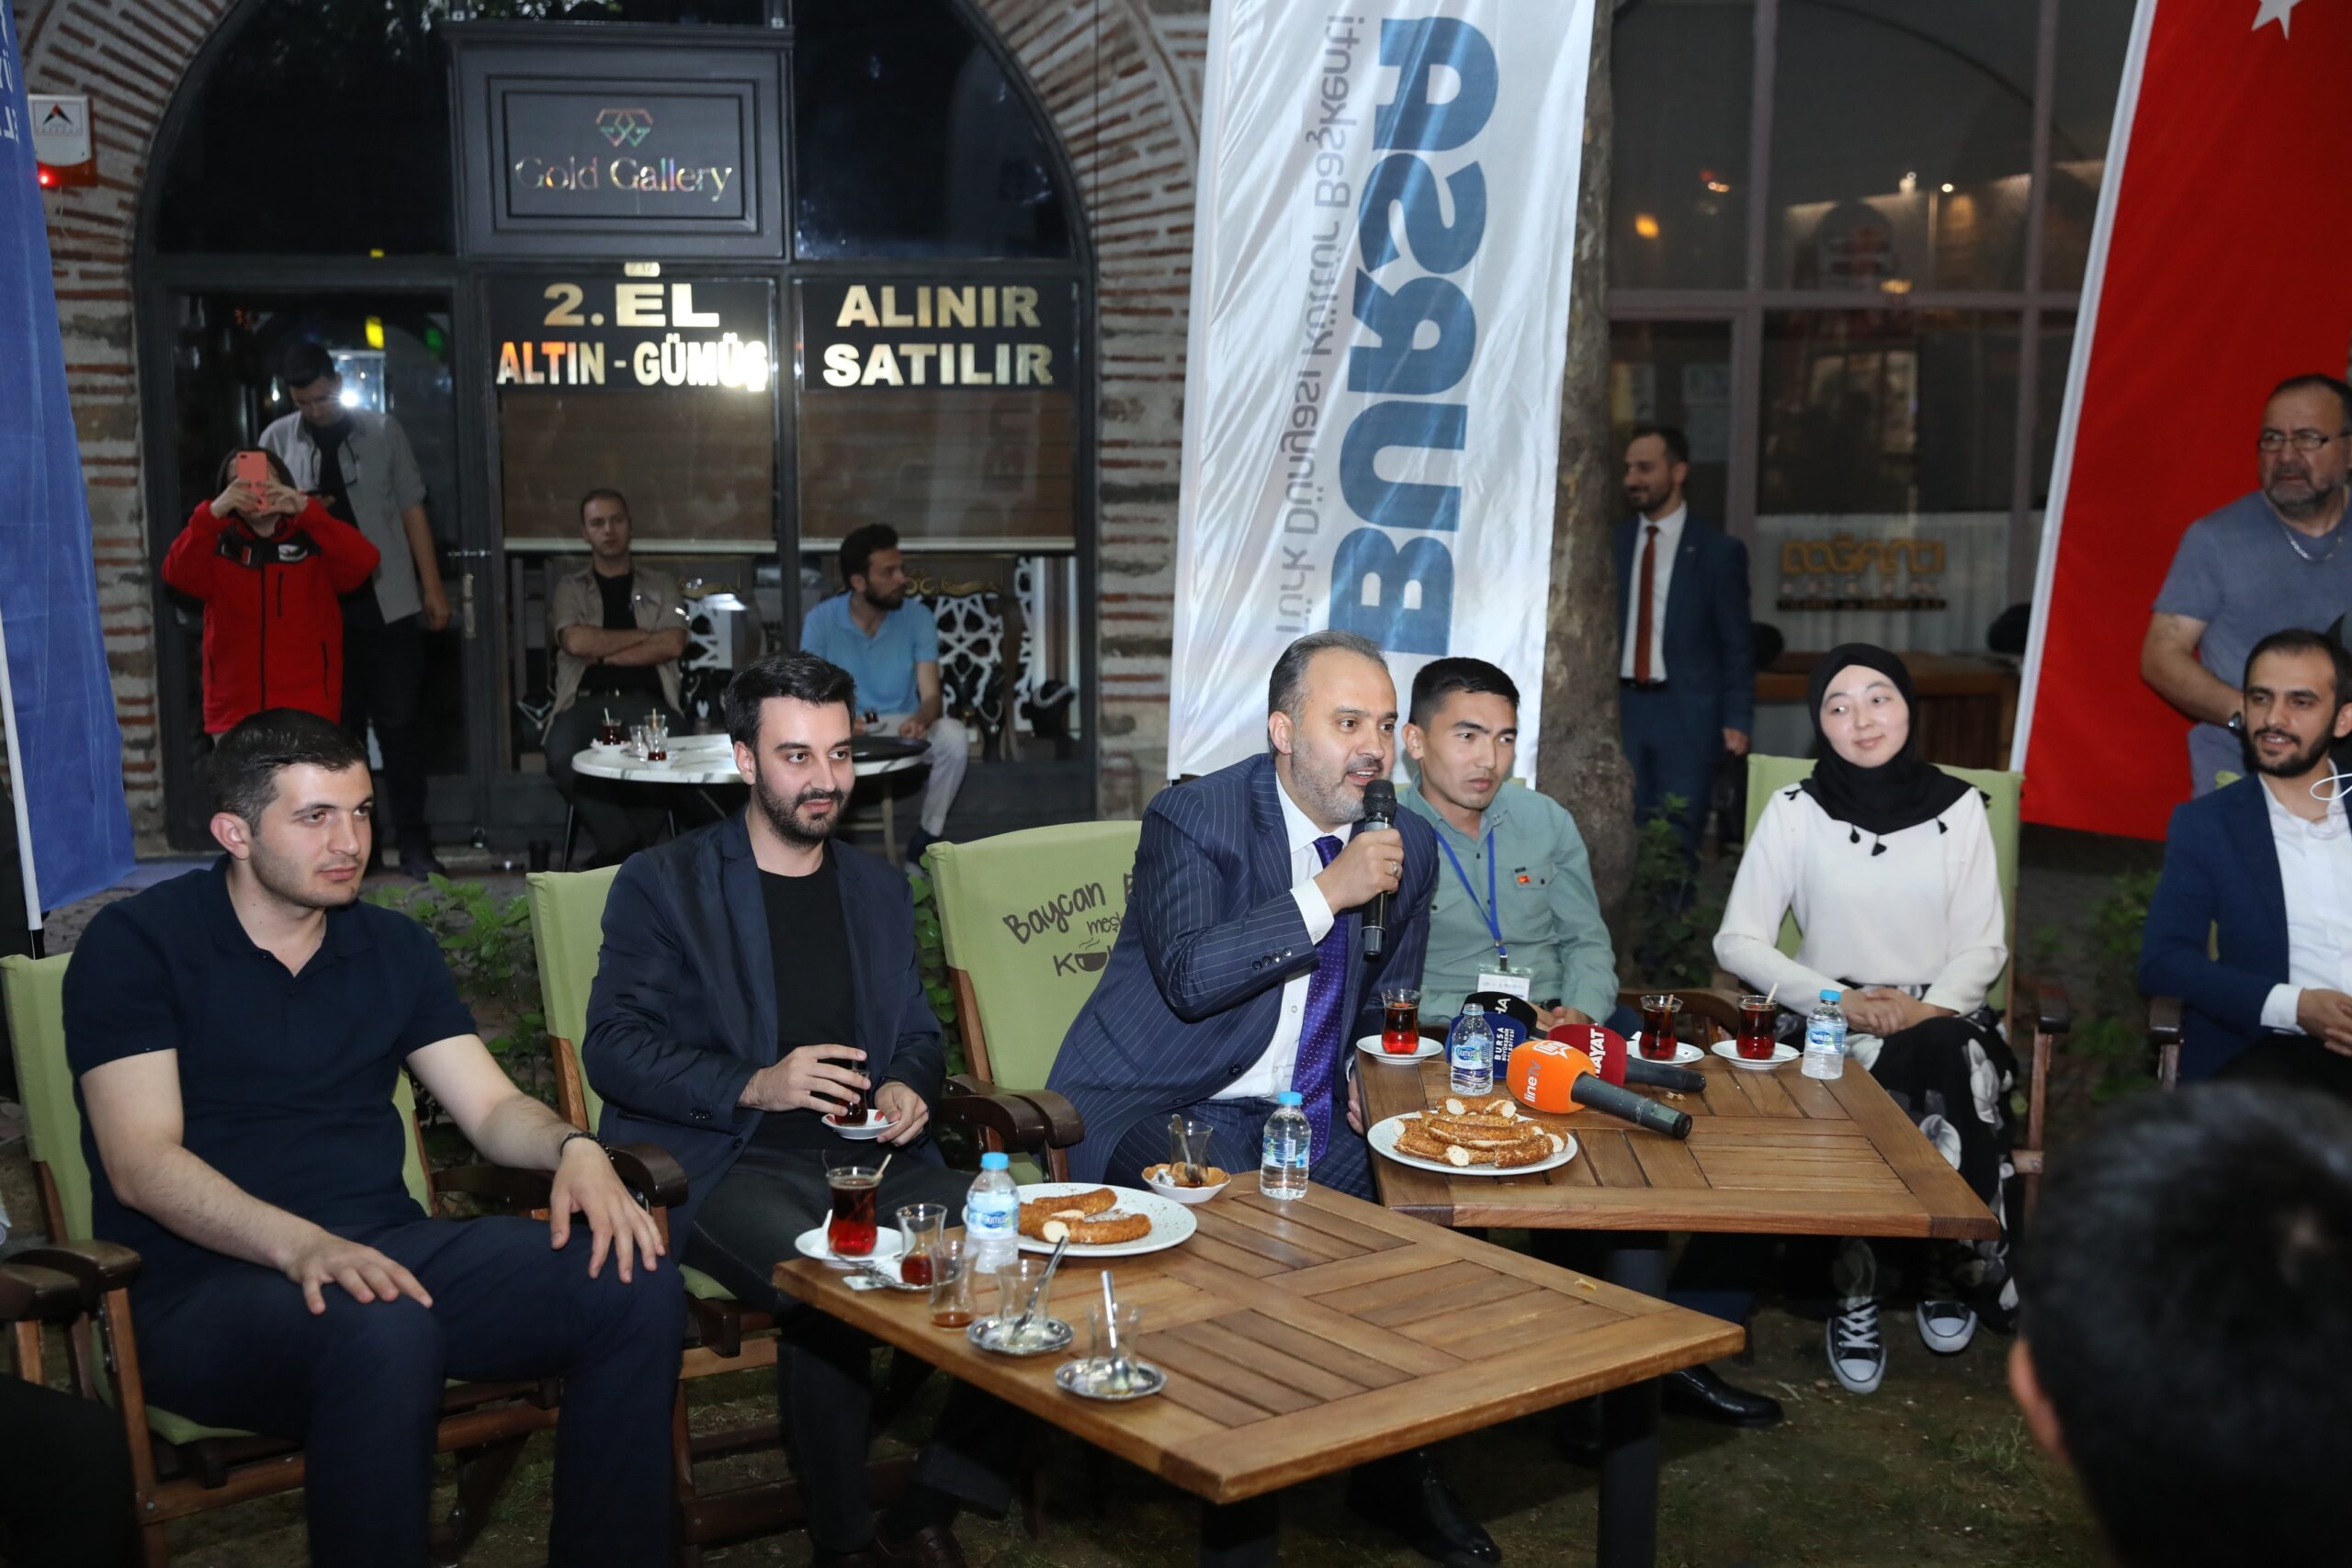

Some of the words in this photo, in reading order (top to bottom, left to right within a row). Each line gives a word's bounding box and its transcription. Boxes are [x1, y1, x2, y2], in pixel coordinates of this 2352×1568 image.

[514, 155, 598, 191] Gold
[609, 155, 733, 202] Gallery
[543, 282, 605, 327] 2.
[615, 282, 720, 328] EL
[835, 285, 1043, 328] ALINIR
[496, 341, 605, 385] ALTIN
[822, 343, 1055, 386] SATILIR
[1002, 882, 1106, 944] Baycan
[1494, 1027, 1505, 1061] BURSA
